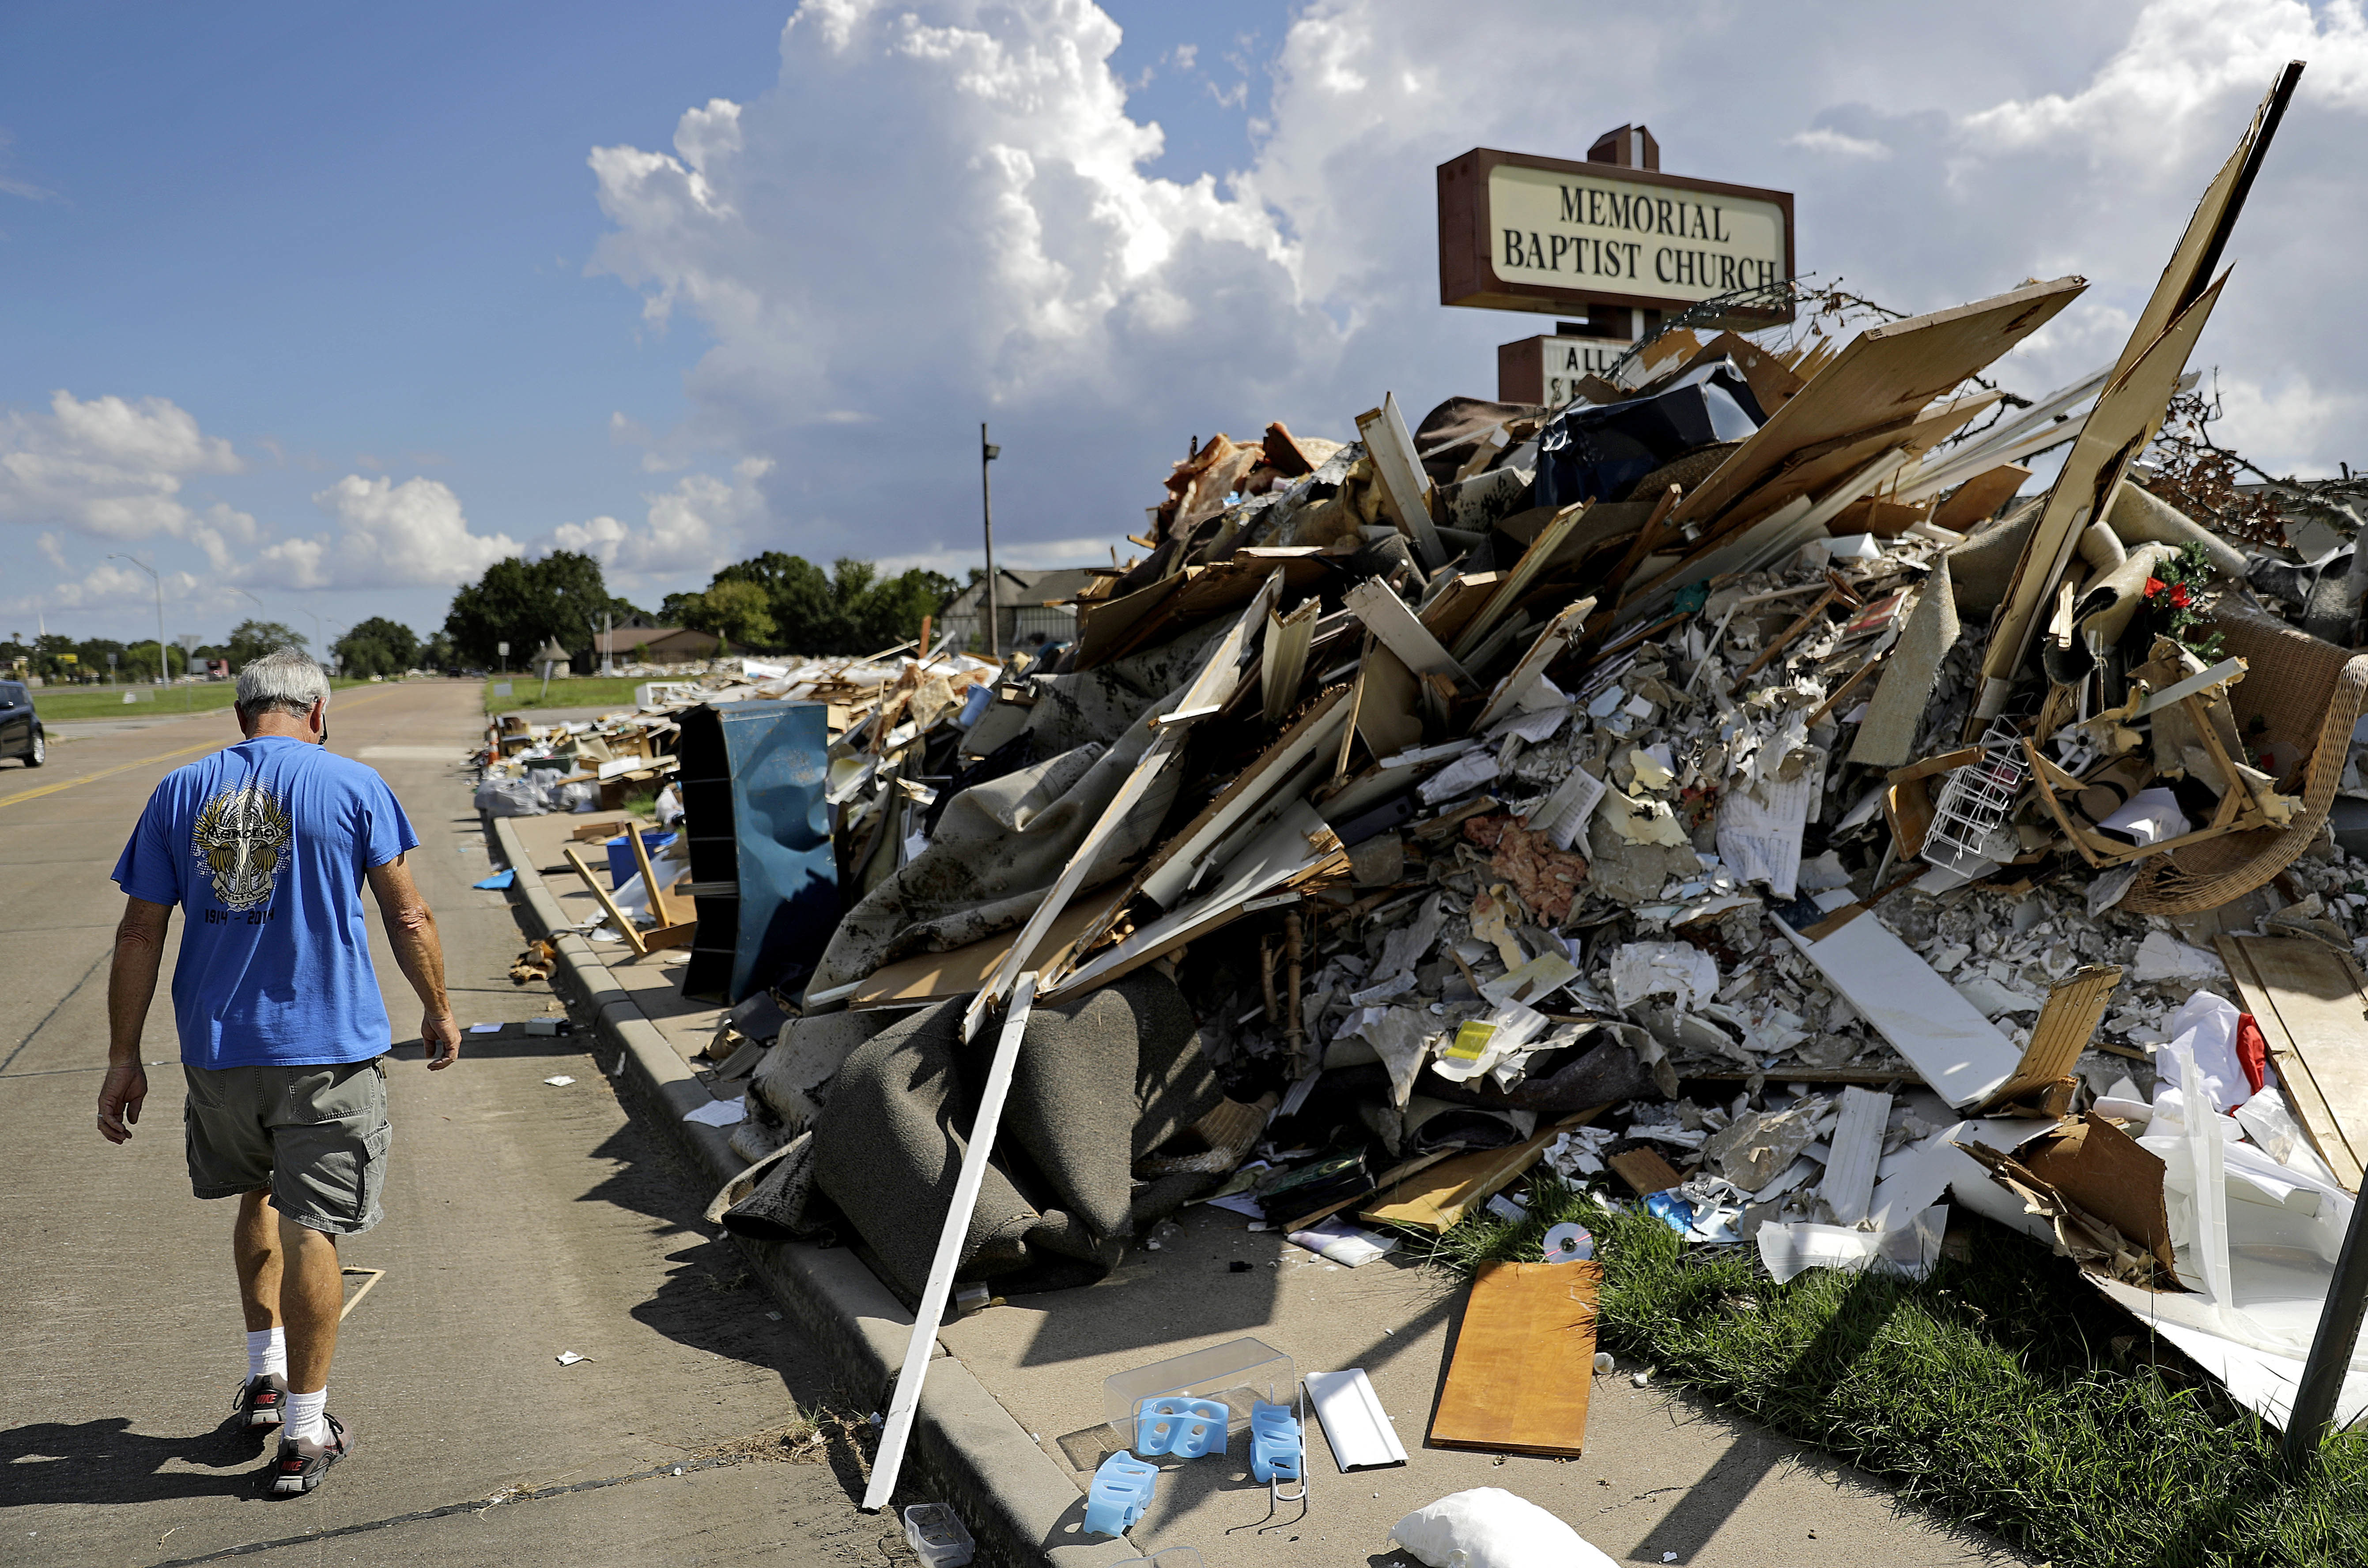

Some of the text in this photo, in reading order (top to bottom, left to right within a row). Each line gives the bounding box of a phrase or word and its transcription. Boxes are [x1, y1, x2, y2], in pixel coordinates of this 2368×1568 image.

[1560, 185, 1730, 243] MEMORIAL
[1503, 230, 1776, 292] BAPTIST CHURCH
[1566, 347, 1609, 371] ALL
[208, 824, 279, 840] Memorial
[217, 886, 272, 900] Baptist Church
[205, 908, 228, 925] 1914
[247, 908, 276, 925] 2014
[254, 1394, 277, 1404] NIKE
[281, 1461, 303, 1470] NIKE
